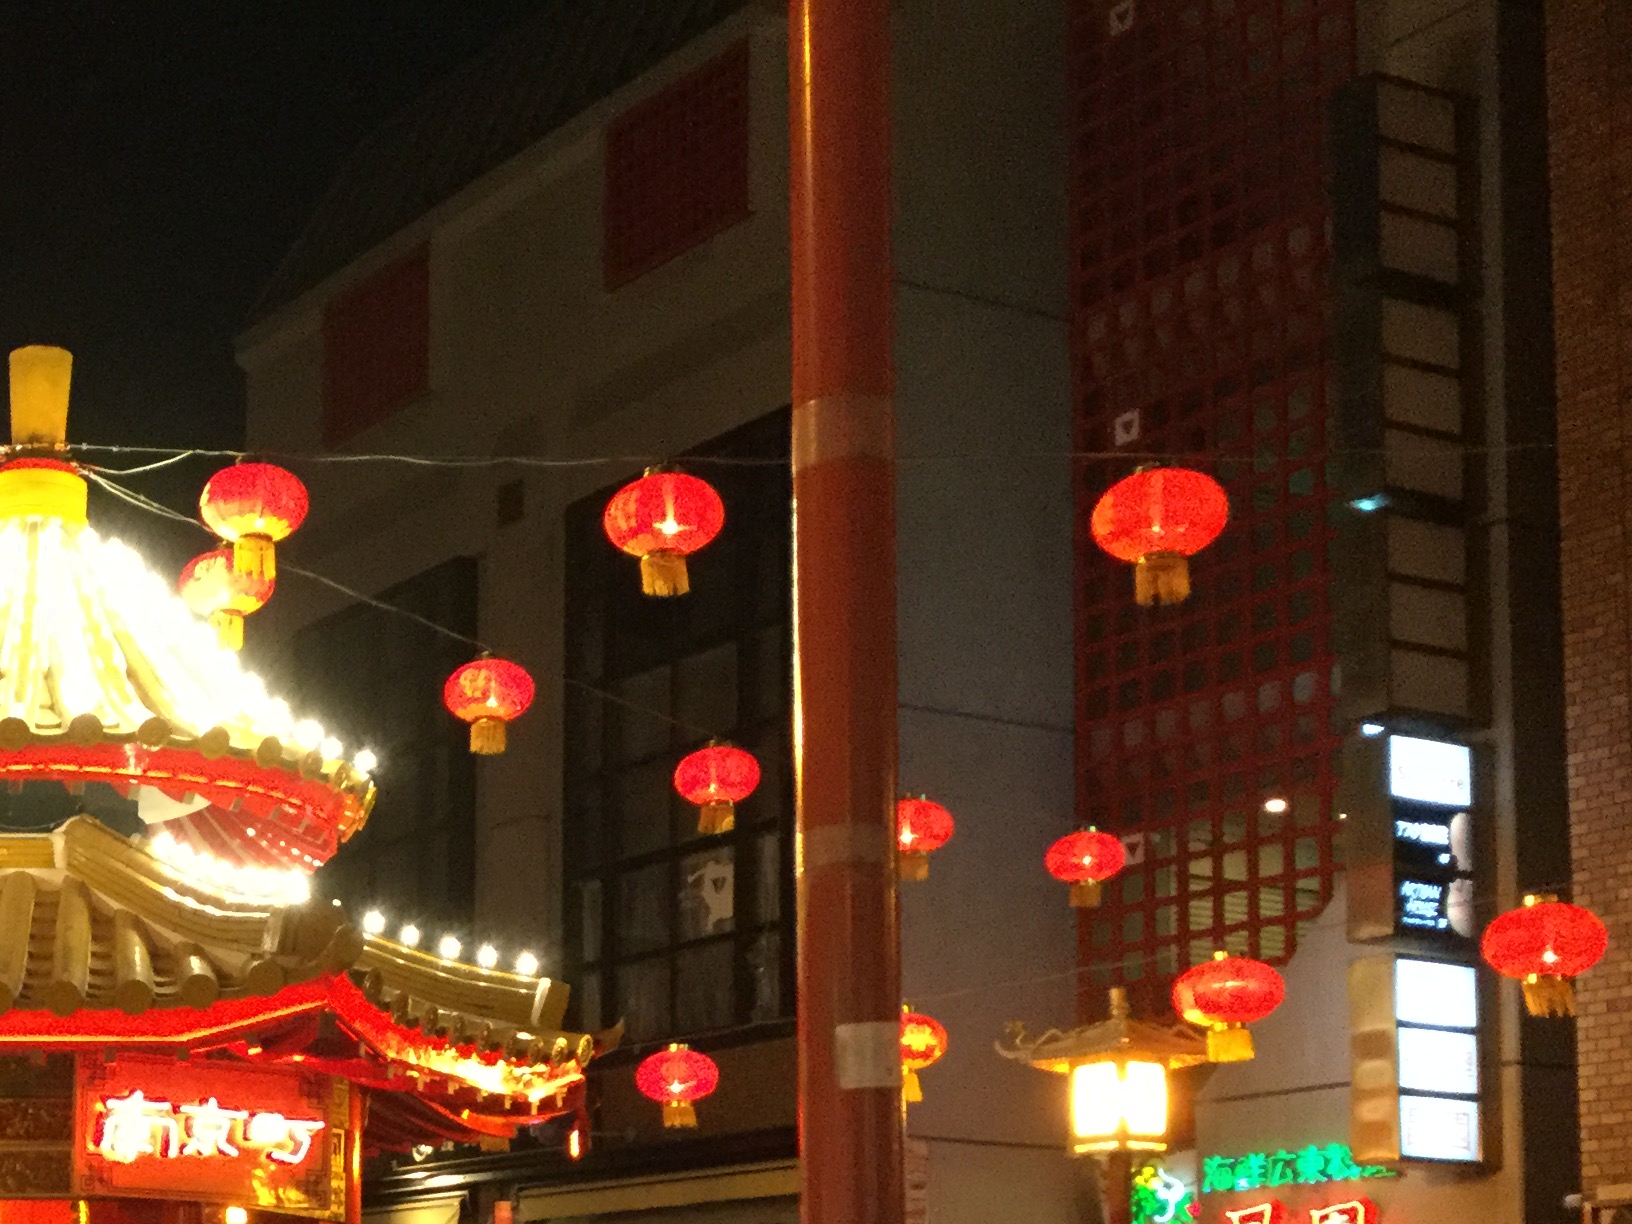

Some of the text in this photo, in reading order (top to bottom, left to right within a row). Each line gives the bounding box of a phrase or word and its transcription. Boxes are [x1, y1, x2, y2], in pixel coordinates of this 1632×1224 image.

[96, 1089, 326, 1165] 南京町
[1202, 1142, 1399, 1194] 海鮮広東料
